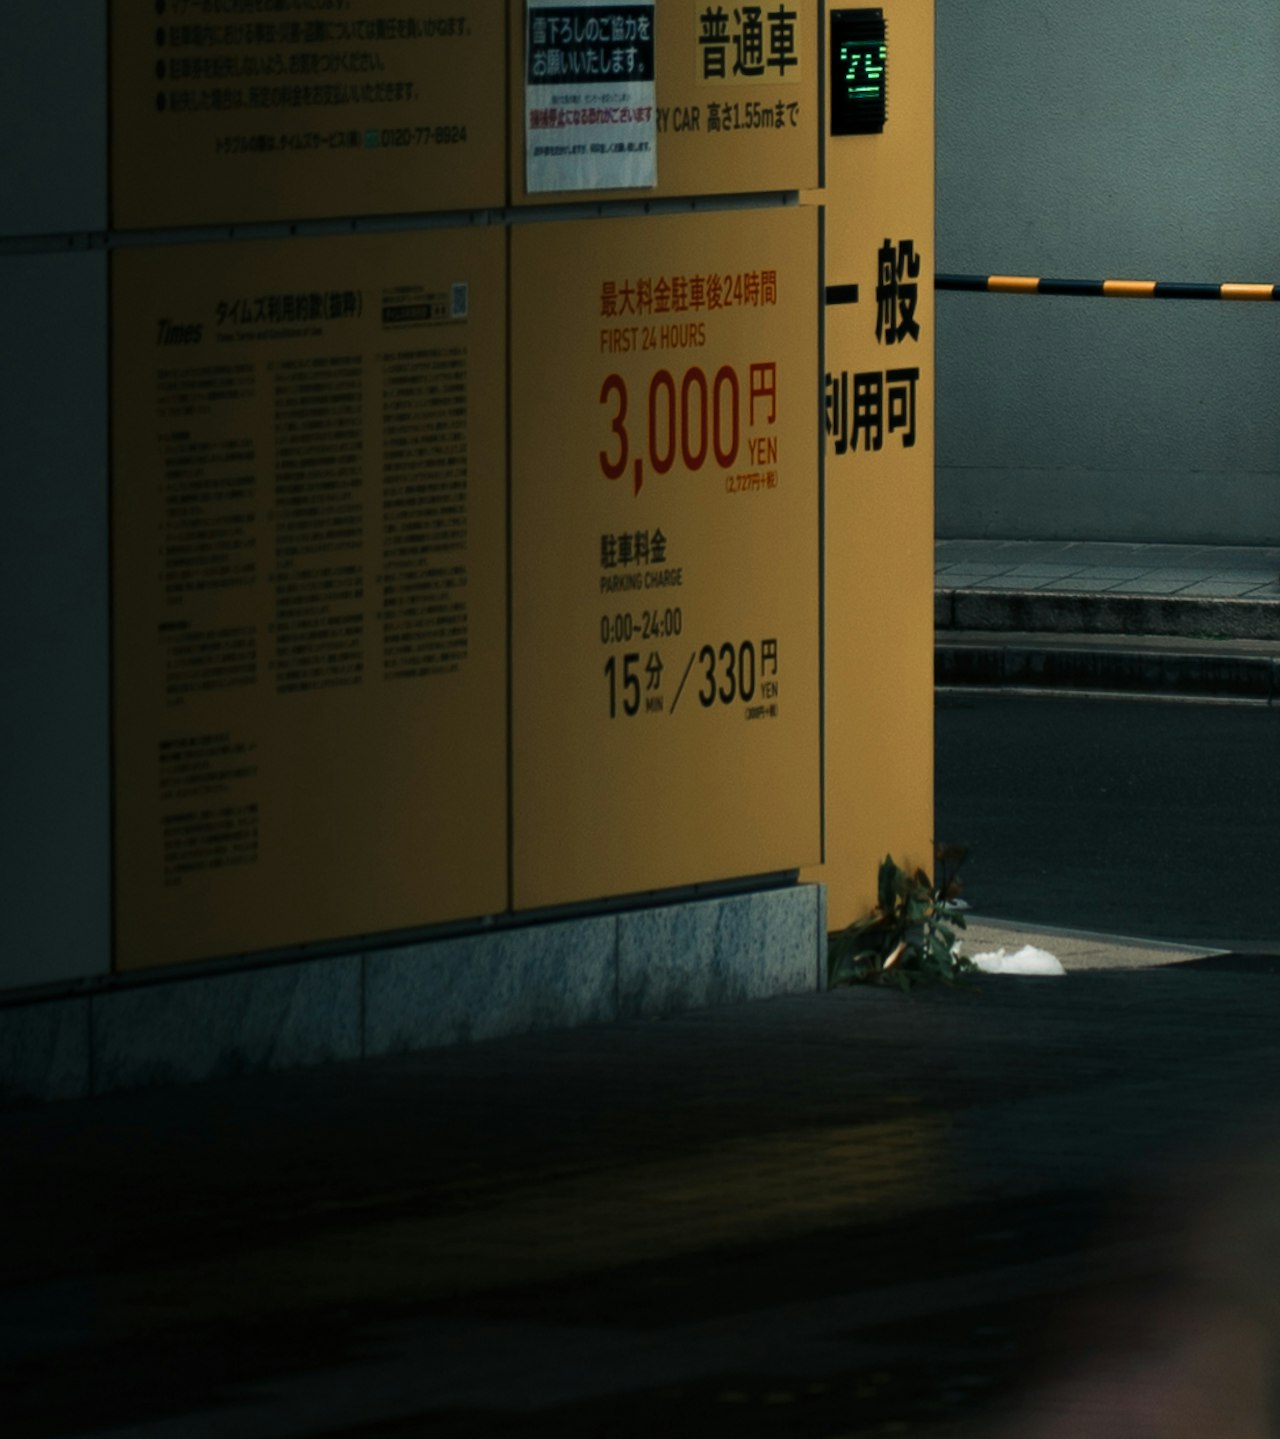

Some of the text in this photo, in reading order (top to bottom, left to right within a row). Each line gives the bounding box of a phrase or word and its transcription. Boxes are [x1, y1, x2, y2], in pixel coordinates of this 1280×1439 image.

[532, 14, 651, 45] 雪下ろしのご協力を
[699, 4, 797, 79] 普通車
[531, 45, 645, 77] お願いいたします。
[674, 106, 700, 132] CAR
[707, 101, 799, 133] 高さ1.55mまで
[600, 271, 777, 318] 最大料金駐車後24時間
[825, 238, 920, 345] 一般
[157, 317, 203, 346] Times
[600, 323, 706, 354] FIRST 24 HOURS
[600, 362, 777, 498] 3,000円
[748, 437, 777, 466] YEN
[725, 470, 778, 494] (2,727円+税)
[600, 528, 667, 569] 駐車料金
[600, 567, 683, 595] PARKING CHARGE
[601, 607, 682, 645] 0:00~24:00
[645, 697, 664, 714] MIN
[760, 681, 778, 700] YEN
